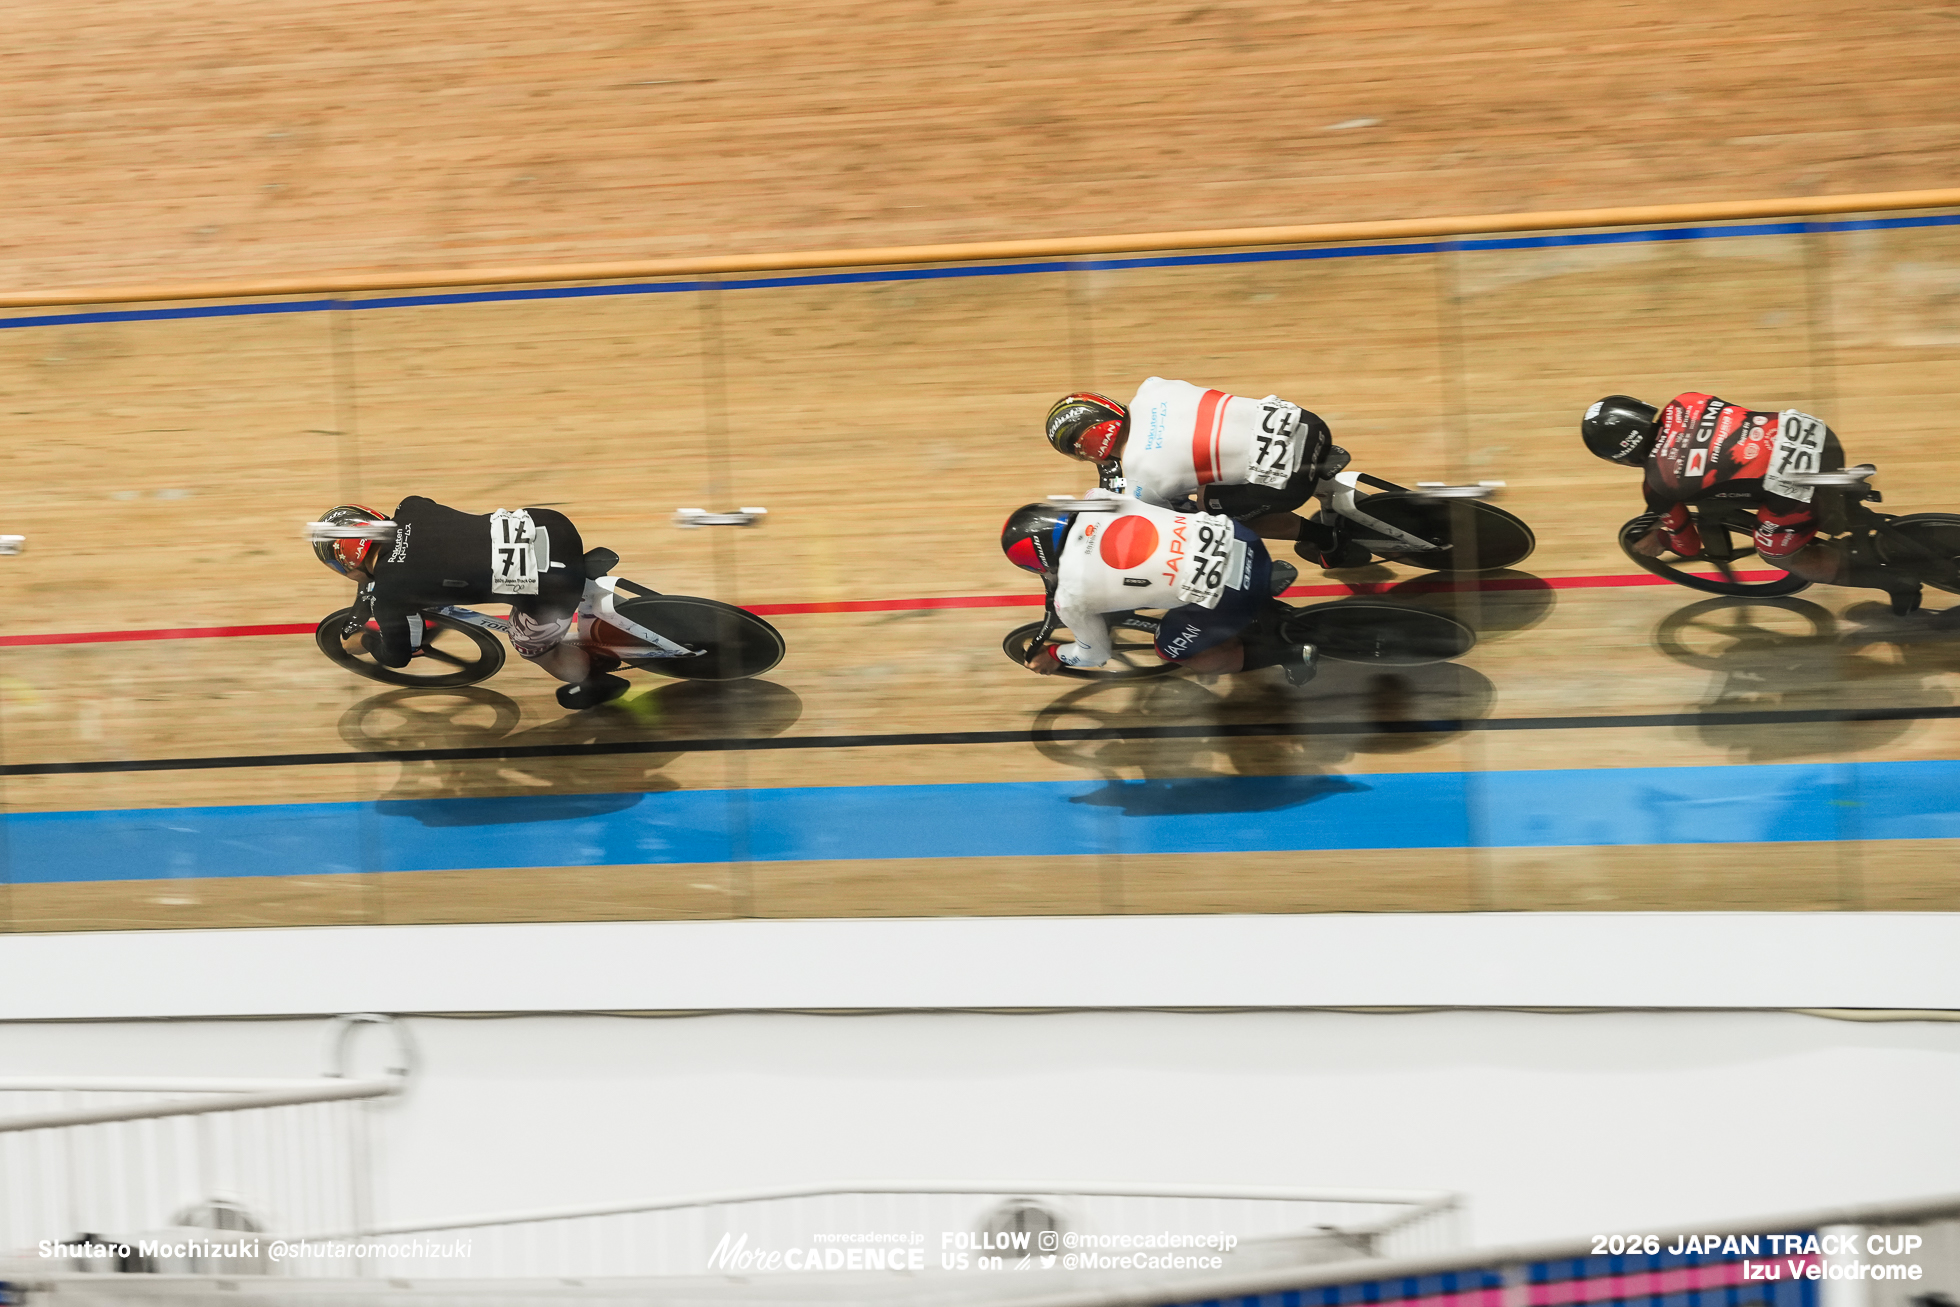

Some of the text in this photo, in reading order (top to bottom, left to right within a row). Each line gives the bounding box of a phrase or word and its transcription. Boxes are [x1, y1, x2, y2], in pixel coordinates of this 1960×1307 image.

[1145, 407, 1157, 450] Rakuten
[1262, 405, 1293, 437] 72
[1696, 400, 1725, 443] CIMB
[1785, 416, 1818, 449] 70
[1097, 424, 1116, 457] JAPAN
[1256, 435, 1287, 470] 72
[1777, 444, 1812, 475] 70
[388, 528, 403, 563] Rakuten
[502, 518, 531, 544] 71
[1198, 525, 1227, 558] 76
[498, 547, 527, 577] 71
[1162, 515, 1187, 586] JAPAN
[1190, 555, 1223, 589] 76
[1163, 624, 1202, 658] JAPAN
